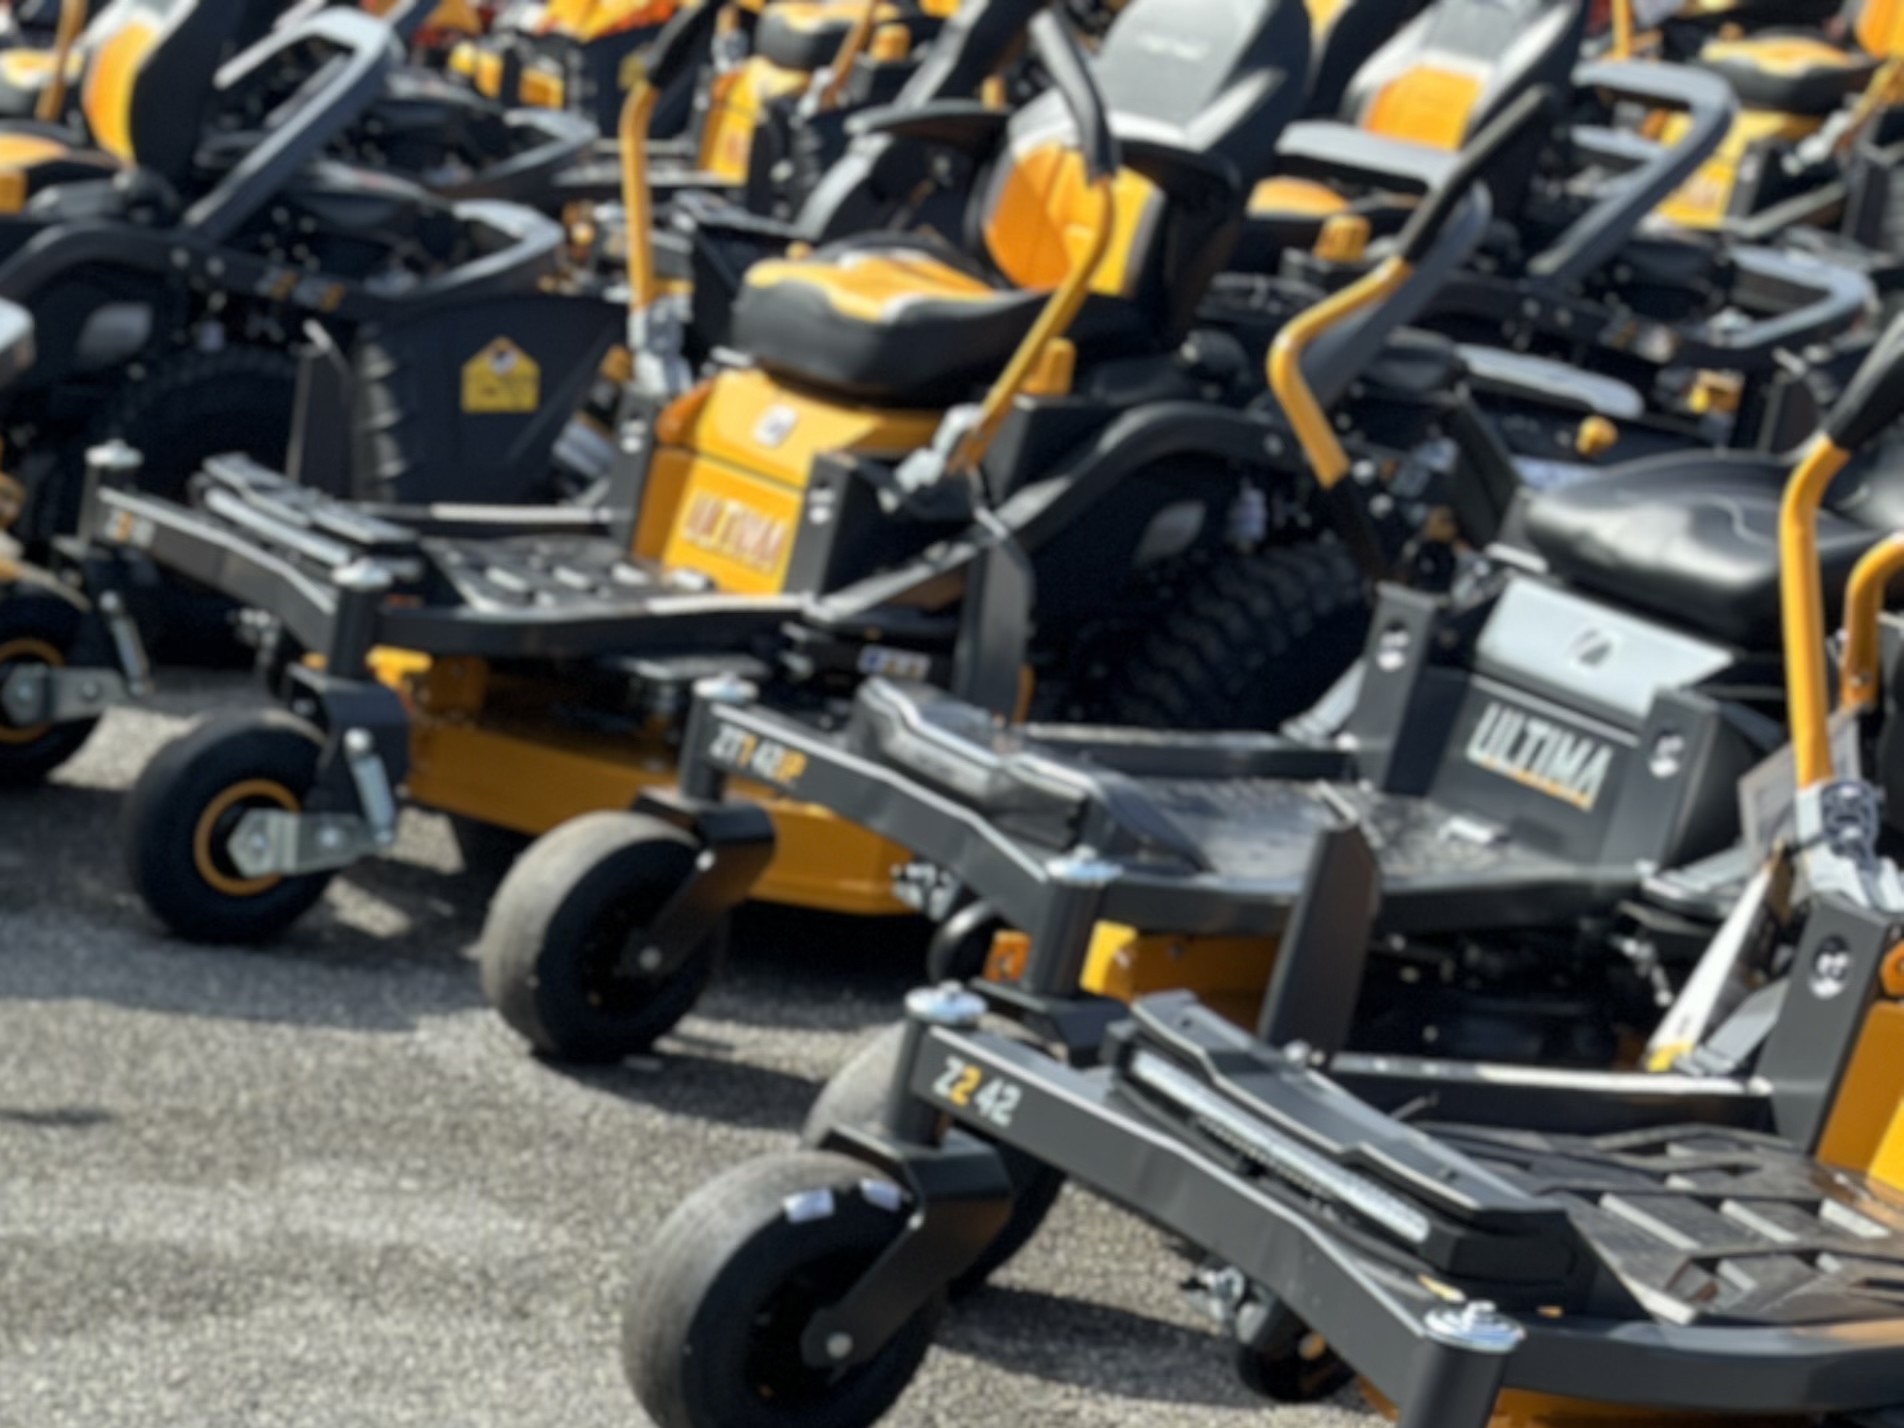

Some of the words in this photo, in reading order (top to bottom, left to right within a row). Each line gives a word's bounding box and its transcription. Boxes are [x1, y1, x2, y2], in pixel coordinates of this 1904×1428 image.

[1467, 701, 1615, 812] ULTIMA
[932, 1055, 983, 1107] Z2
[974, 1077, 1023, 1129] 42
